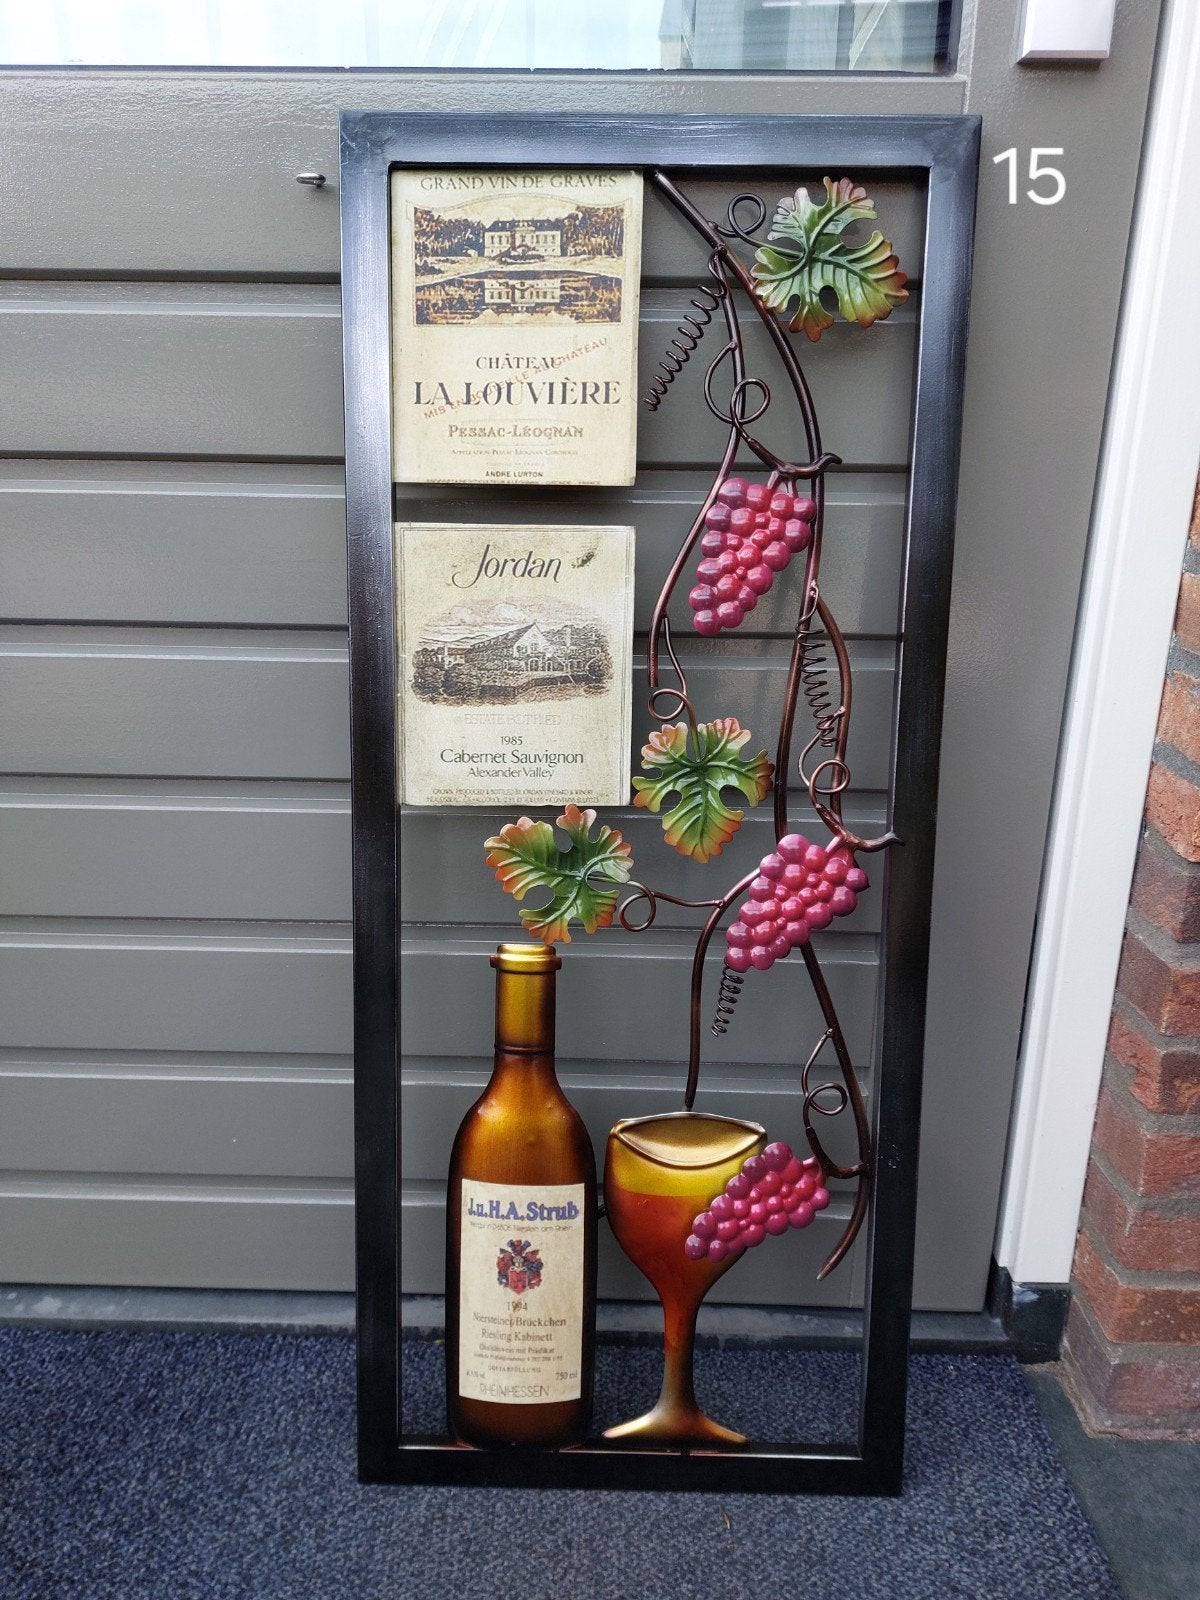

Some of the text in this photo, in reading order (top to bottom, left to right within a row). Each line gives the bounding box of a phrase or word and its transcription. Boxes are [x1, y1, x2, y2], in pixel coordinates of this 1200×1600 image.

[420, 174, 617, 191] GRAND VIN DE GRAVES
[414, 377, 621, 405] LA LOUVIÈRE
[424, 405, 447, 420] MIS
[451, 544, 562, 588] Jordan
[500, 736, 523, 746] 1985
[440, 748, 584, 768] Cabernet Sauvignon
[467, 767, 555, 780] Alexander Valley
[481, 1328, 553, 1343] Riesling Kabinett
